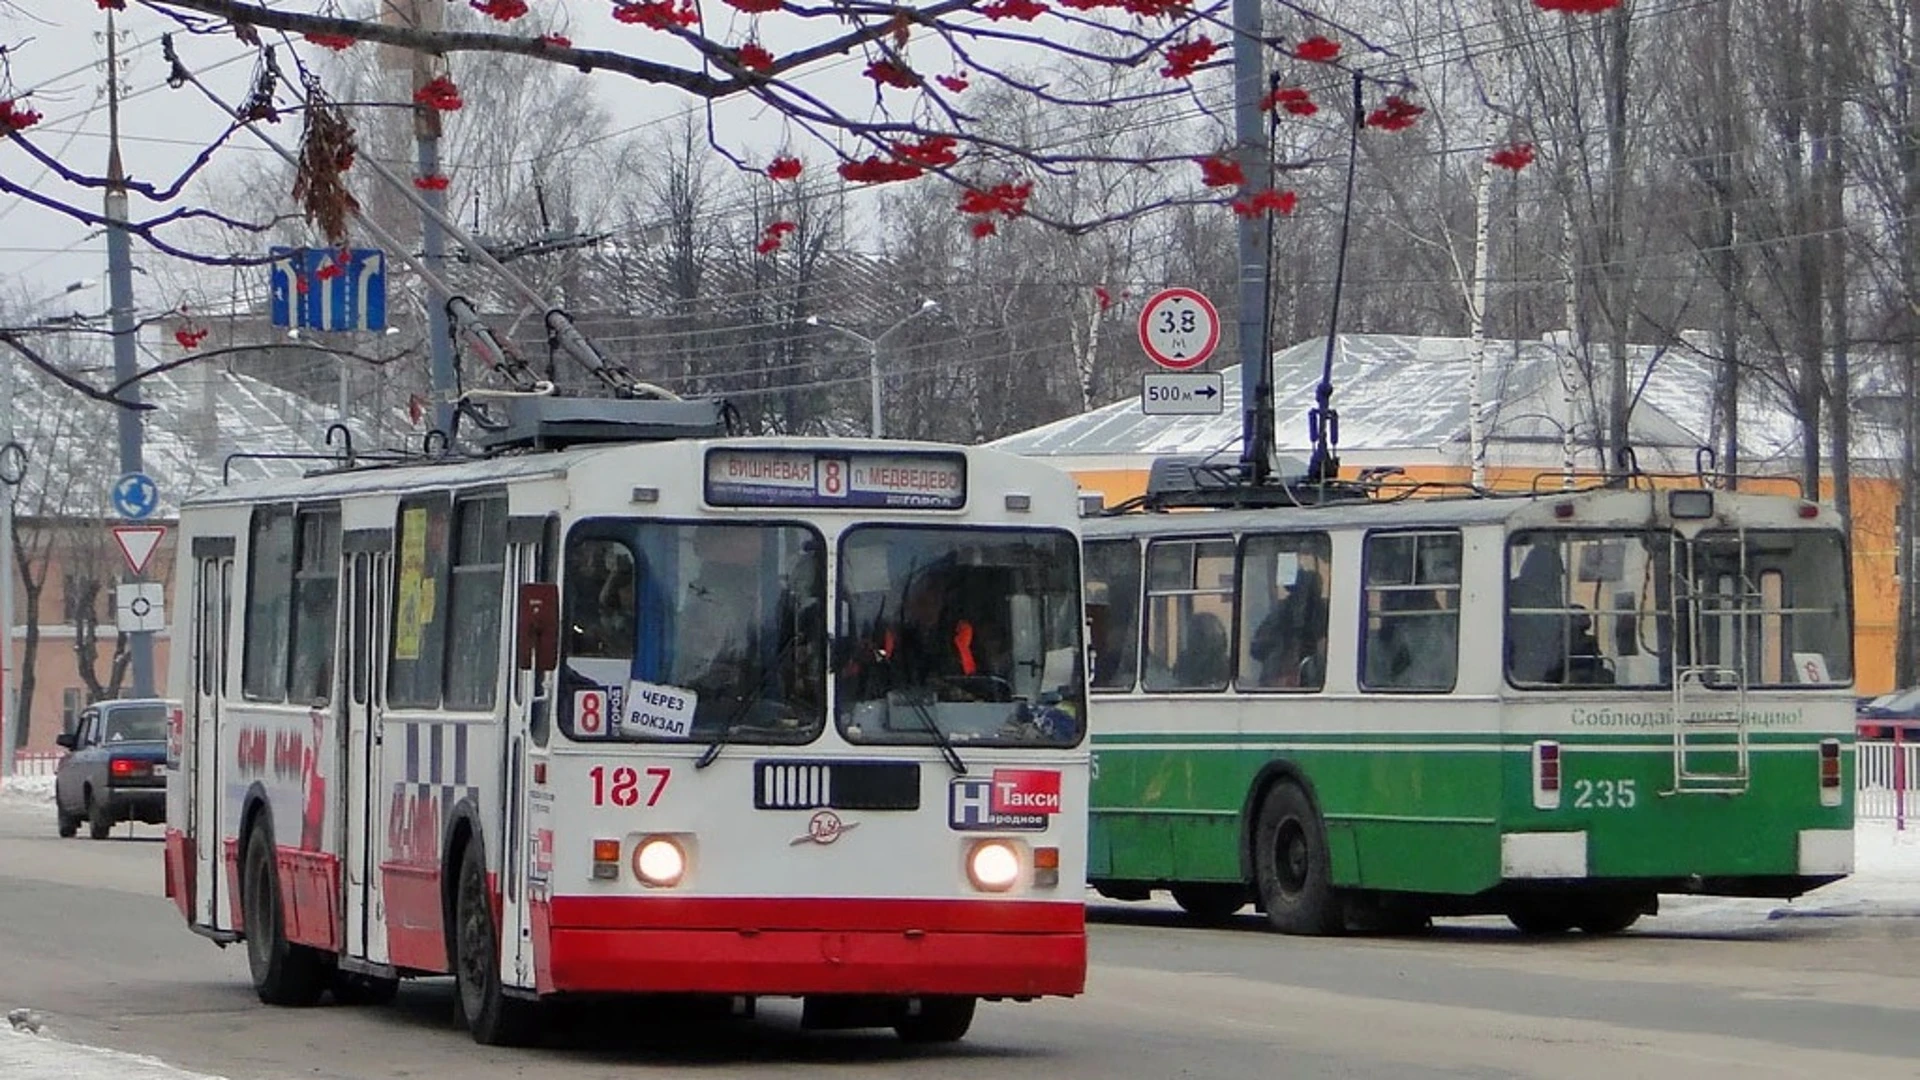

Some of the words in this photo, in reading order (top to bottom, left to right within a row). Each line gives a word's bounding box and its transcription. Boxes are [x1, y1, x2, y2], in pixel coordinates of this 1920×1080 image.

[1149, 386, 1180, 401] 500
[729, 459, 811, 481] ВИШНЕВАЯ
[825, 462, 842, 494] 8
[581, 693, 600, 732] 8
[643, 690, 684, 711] ЧЕРЕЗ
[631, 711, 684, 734] ВОКЗАЛ
[589, 766, 671, 806] 187
[998, 782, 1058, 806] Такси
[1574, 779, 1636, 809] 235
